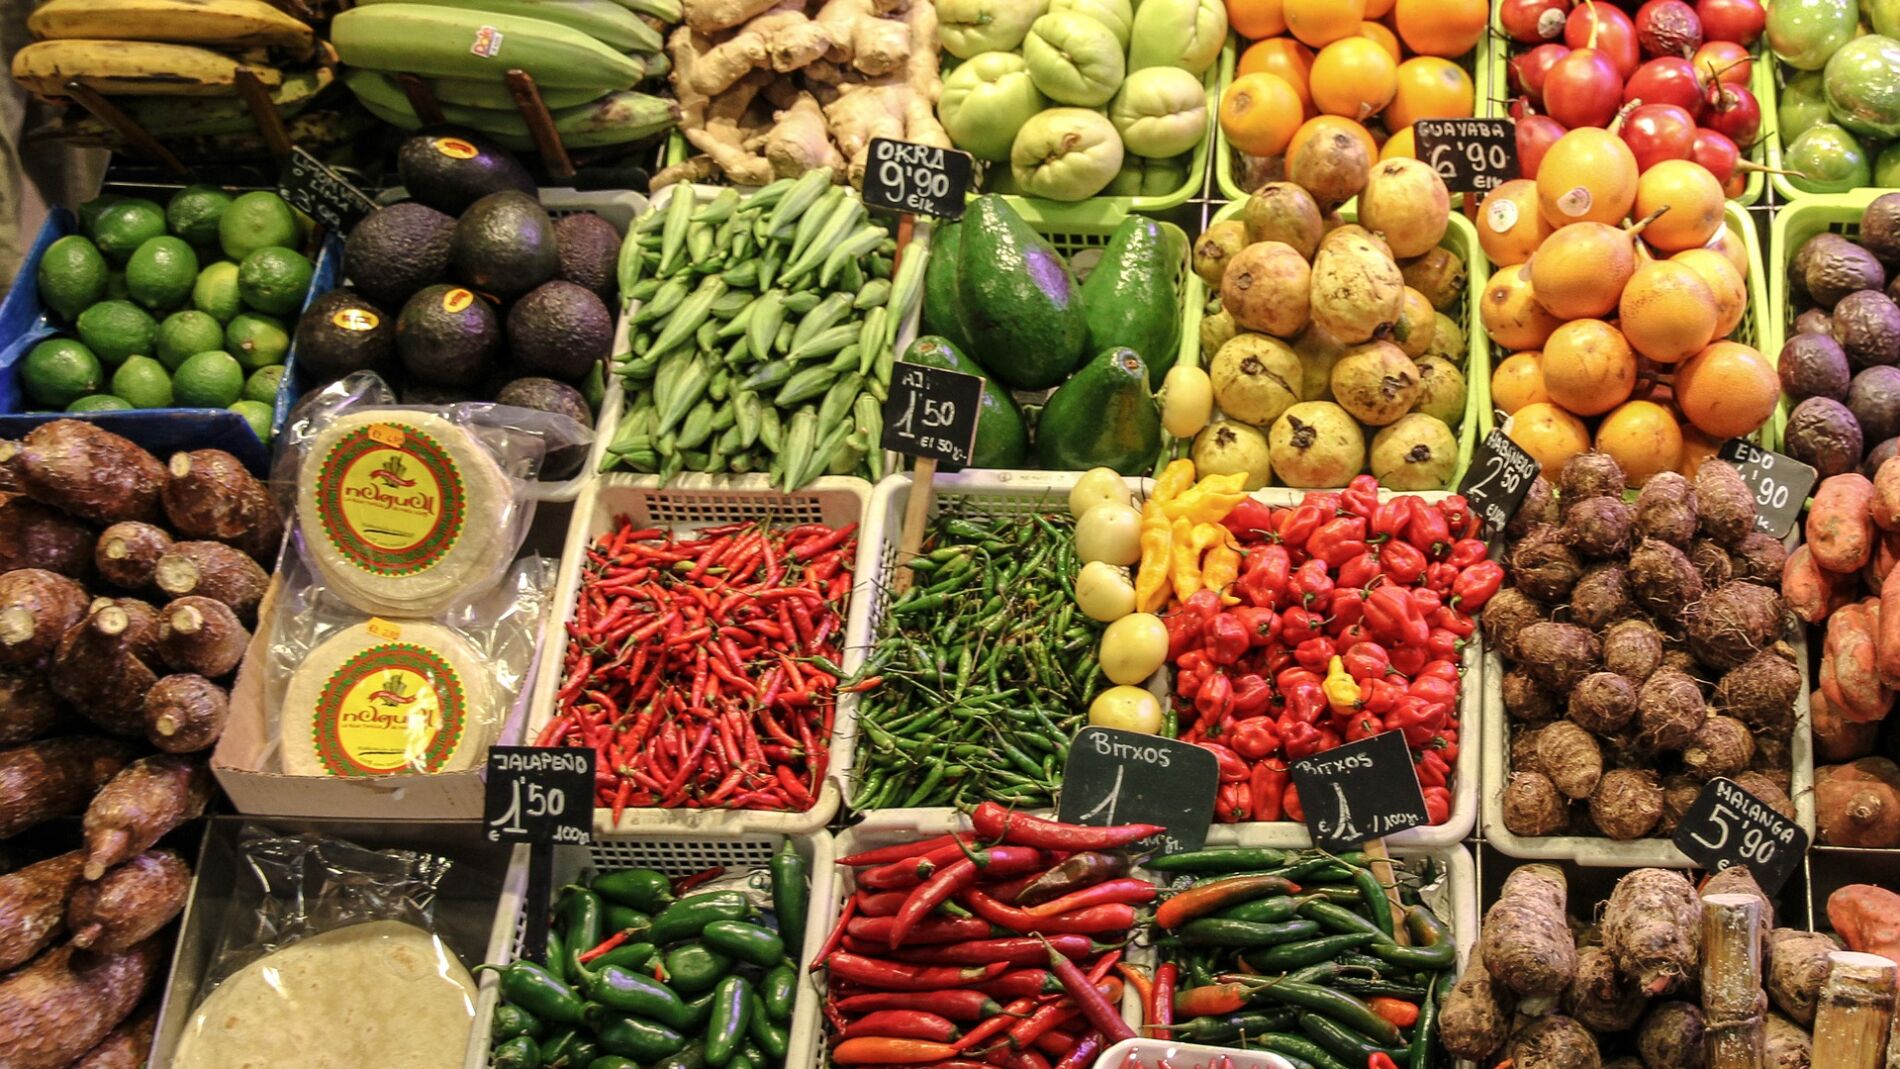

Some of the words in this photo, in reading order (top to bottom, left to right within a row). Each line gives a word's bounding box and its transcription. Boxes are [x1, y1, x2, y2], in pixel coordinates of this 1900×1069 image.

[1418, 121, 1505, 138] GUAYABA
[877, 141, 945, 170] OKRA
[1430, 141, 1507, 178] 6'90
[879, 161, 950, 203] 9'90
[893, 390, 956, 439] 1'50
[1734, 443, 1775, 470] EDO
[342, 705, 434, 730] nagul
[492, 752, 588, 774] JALAPEÑO
[489, 775, 565, 834] 1'50
[1716, 781, 1795, 844] MALANGA
[1690, 803, 1776, 863] 5'90
